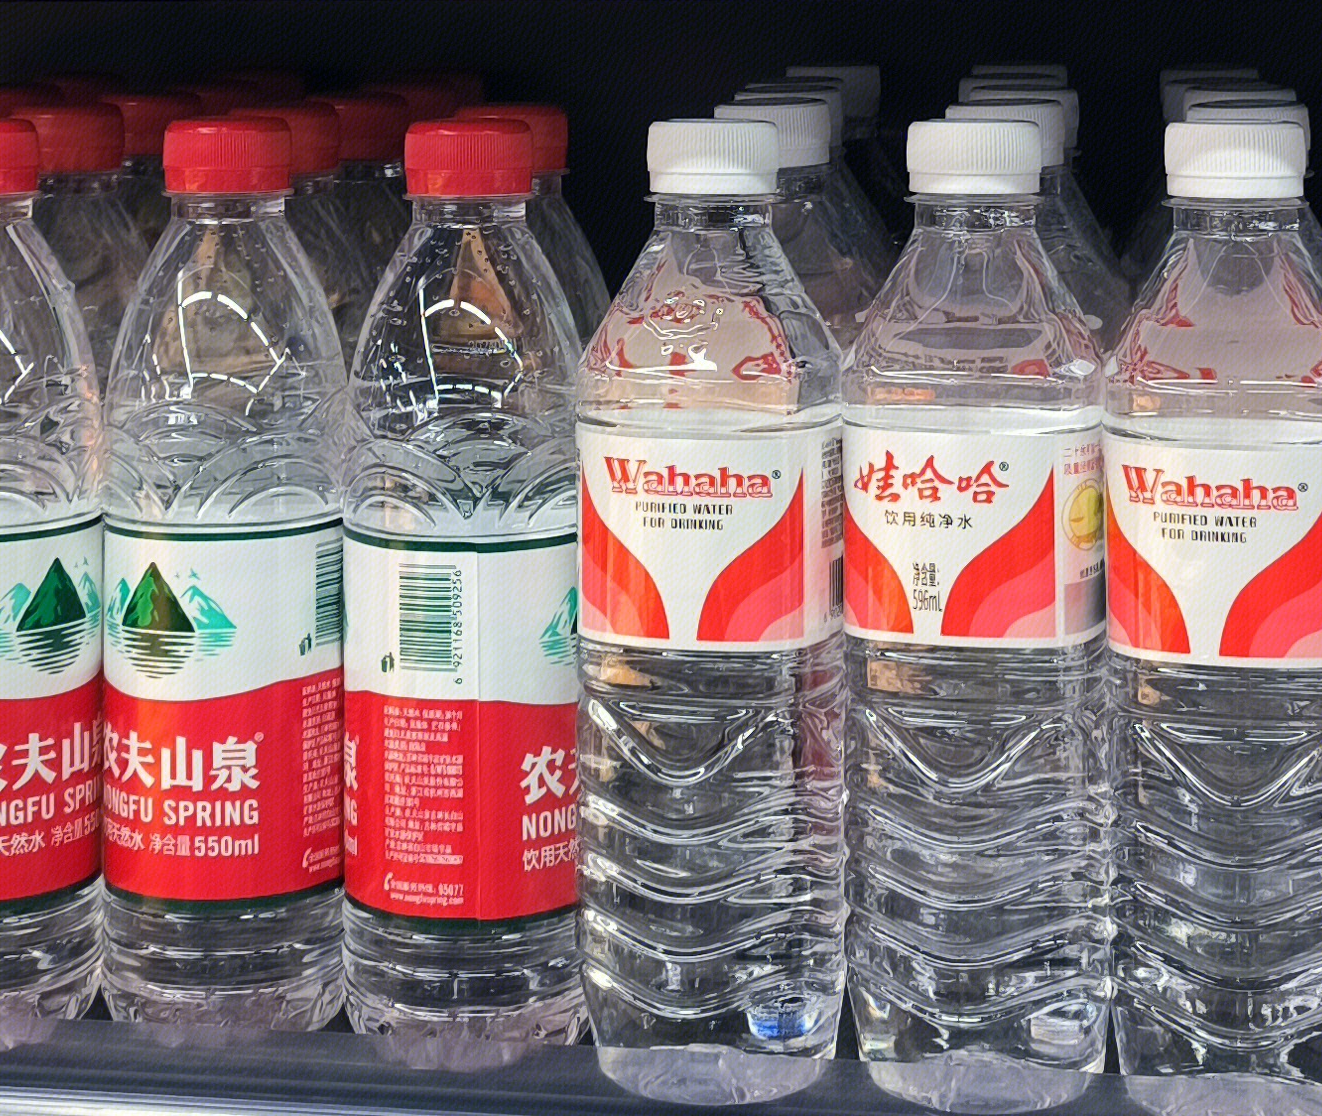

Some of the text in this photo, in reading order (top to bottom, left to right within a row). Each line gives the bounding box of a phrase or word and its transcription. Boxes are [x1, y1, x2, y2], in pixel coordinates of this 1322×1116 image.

[604, 456, 774, 500] Wahaha
[854, 449, 1010, 506] 娃哈哈
[1121, 464, 1299, 512] Wahaha
[635, 500, 734, 516] PURIFIED WATER
[643, 517, 725, 532] FOR DRINKING
[884, 509, 974, 530] 饮用纯净水
[1153, 511, 1257, 529] PURIFIED WATER
[1162, 528, 1247, 545] FOR DRINKING
[163, 798, 260, 827] SPRING
